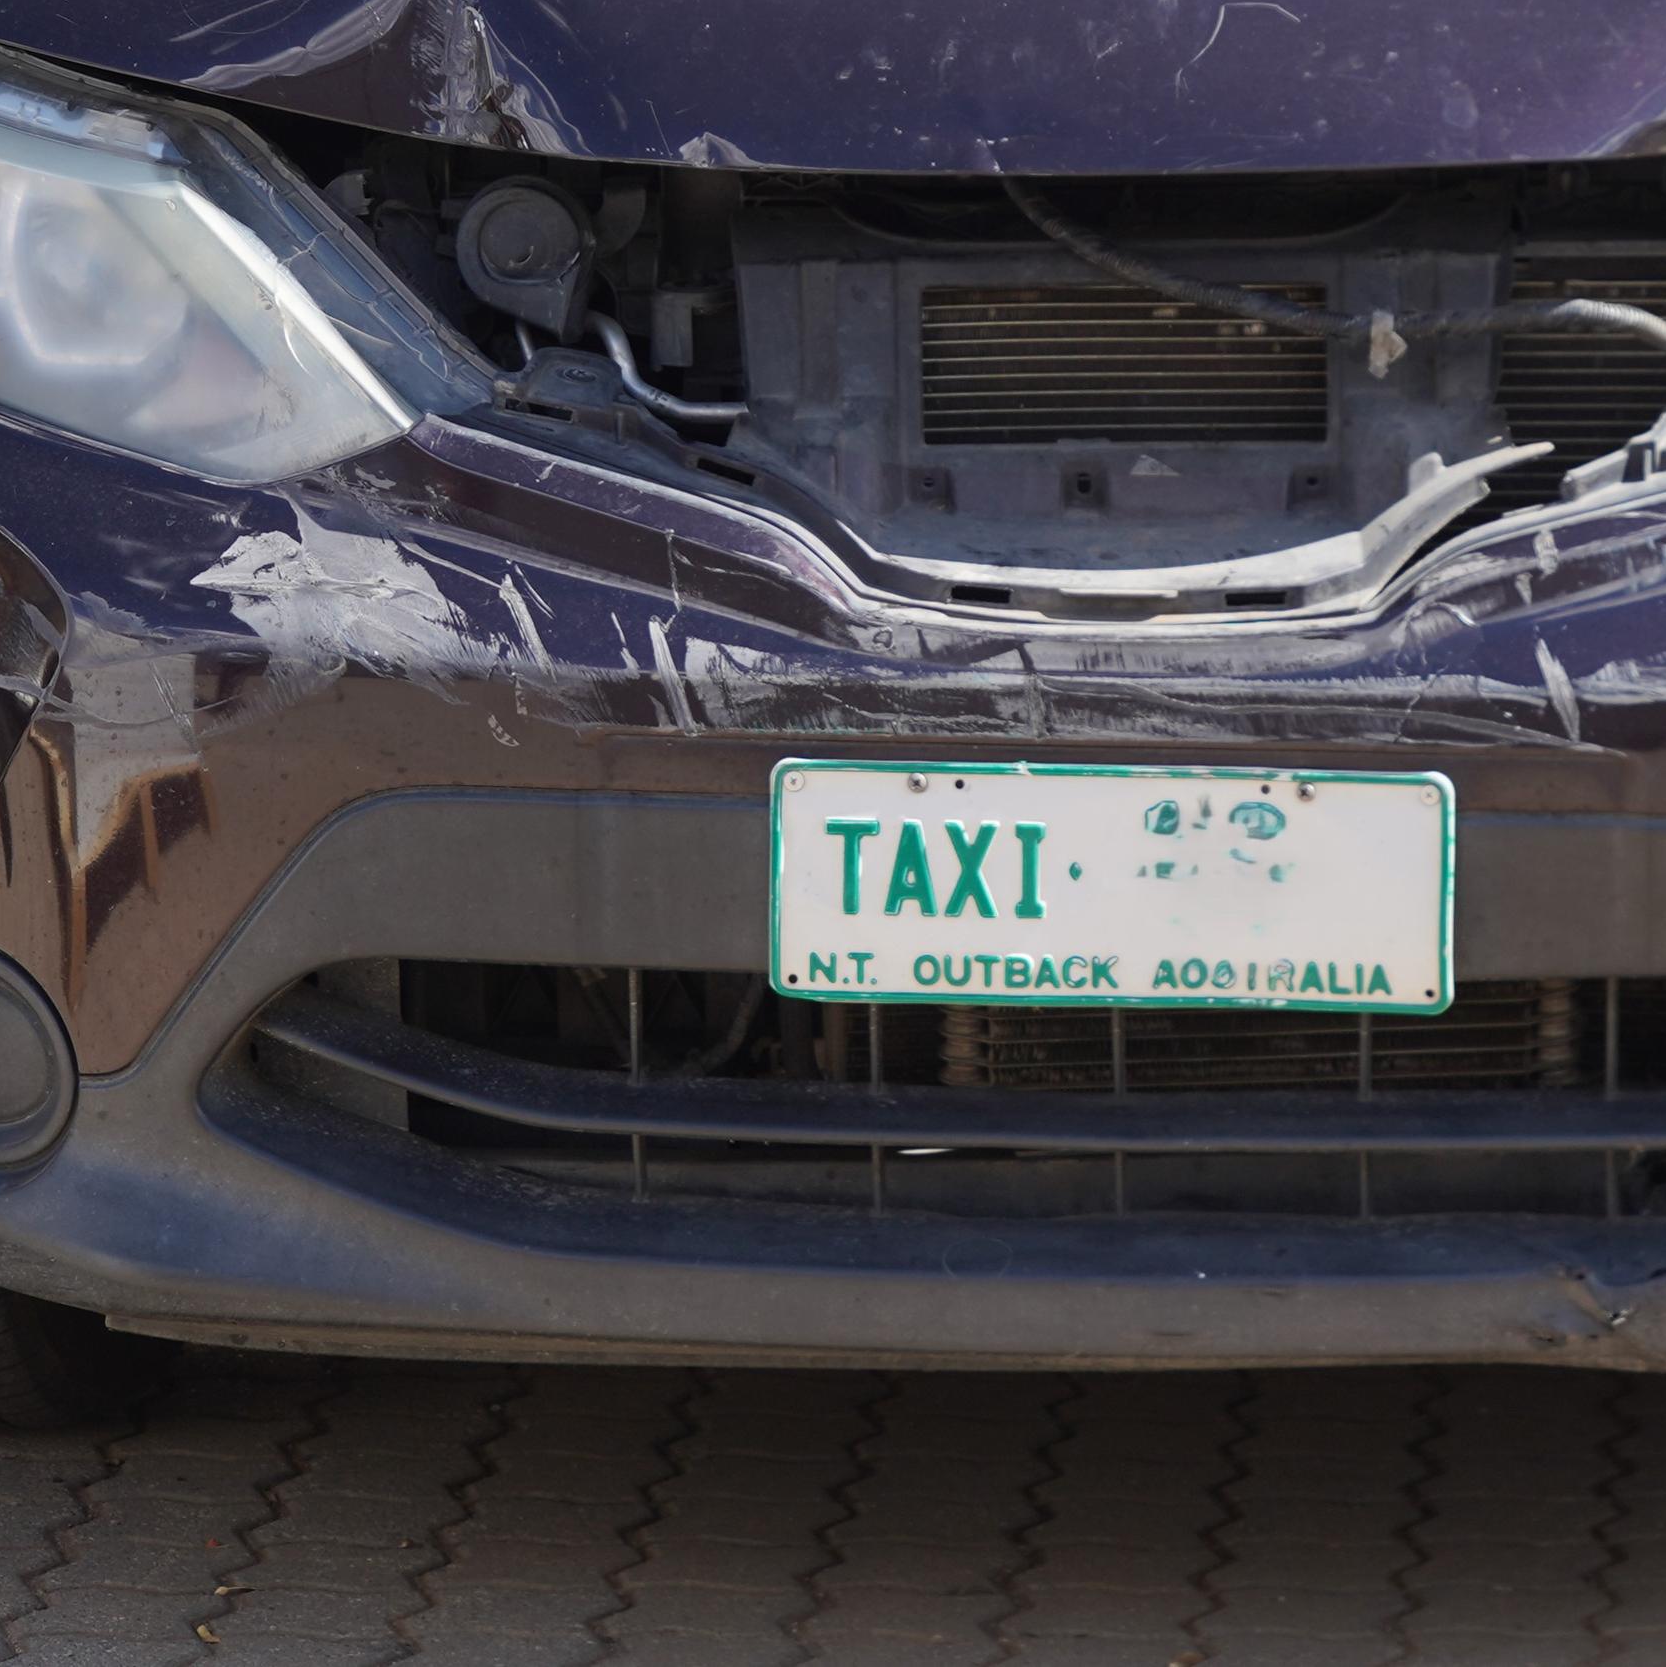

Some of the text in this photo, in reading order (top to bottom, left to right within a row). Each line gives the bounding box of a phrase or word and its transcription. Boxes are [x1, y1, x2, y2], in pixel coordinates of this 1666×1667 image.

[825, 817, 1047, 919] TAXI
[808, 951, 878, 986] N.T.
[912, 952, 1120, 990] OUTBACK
